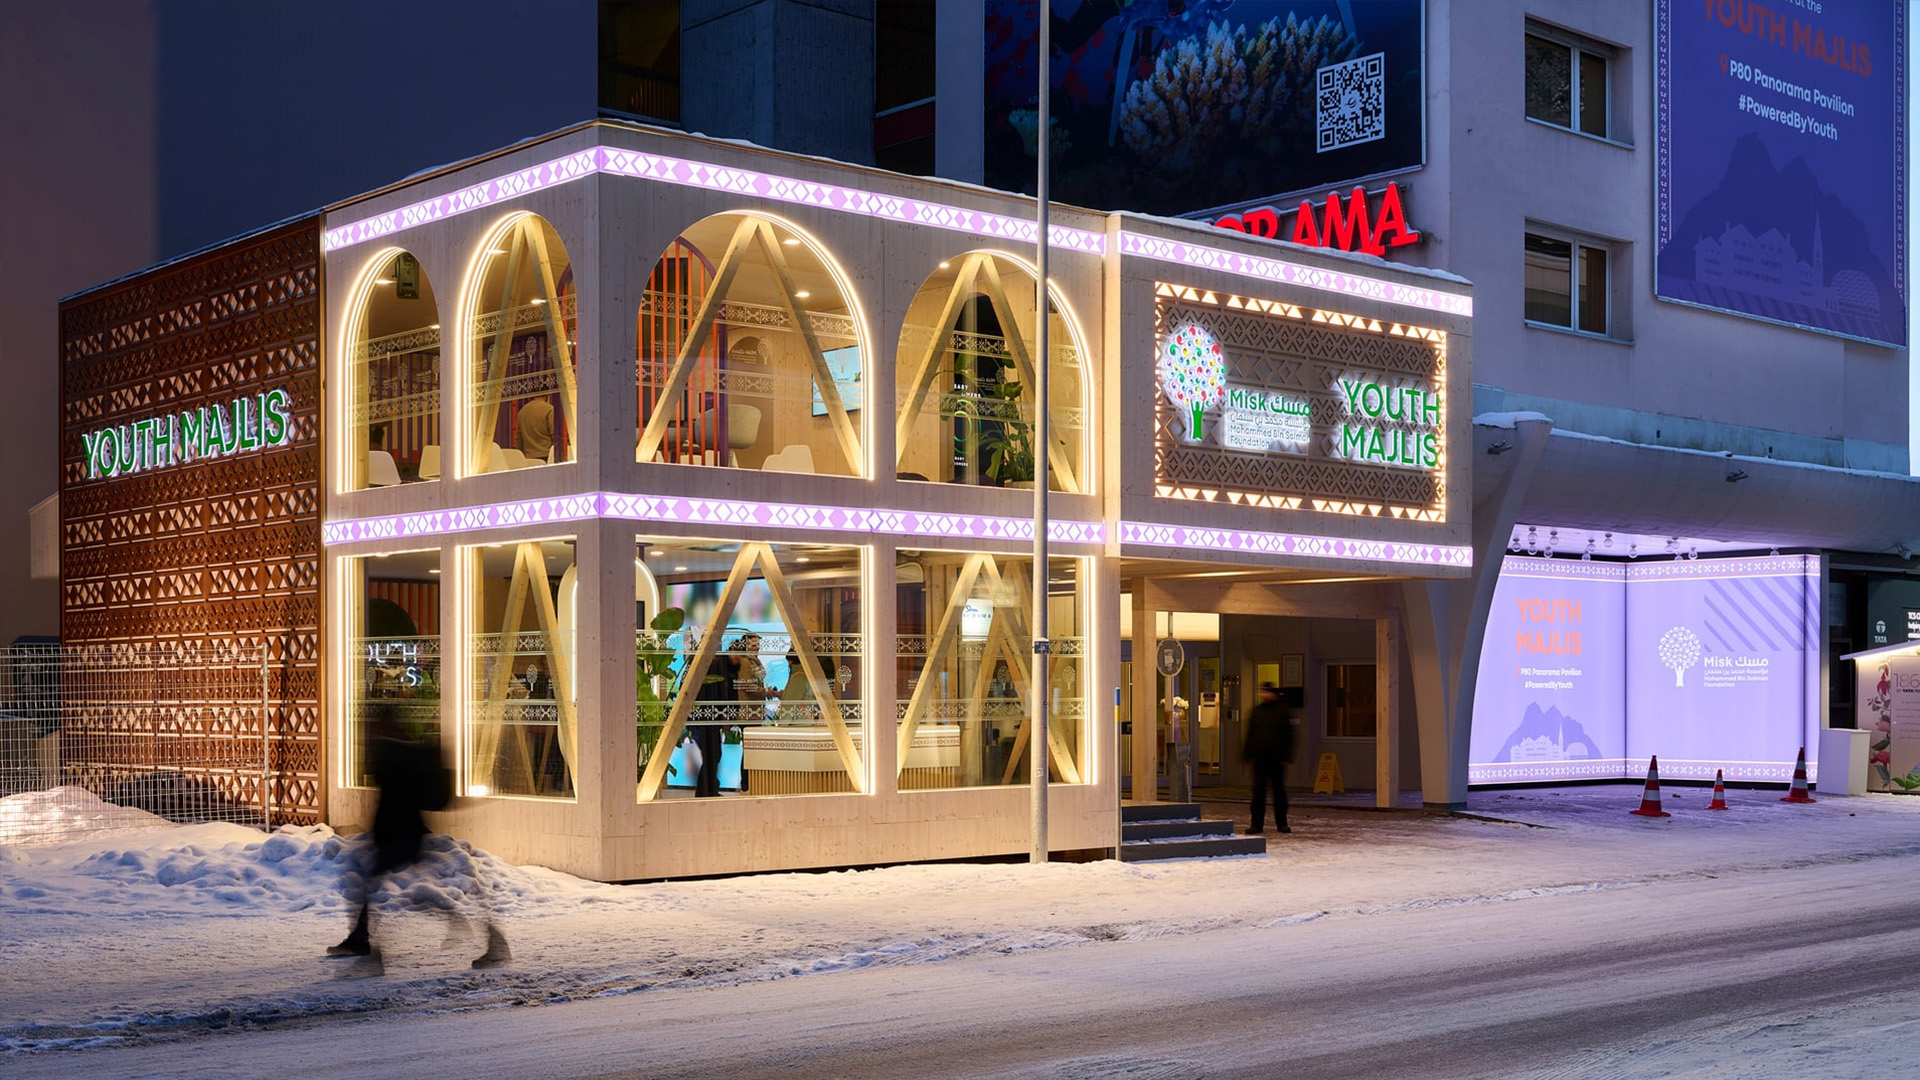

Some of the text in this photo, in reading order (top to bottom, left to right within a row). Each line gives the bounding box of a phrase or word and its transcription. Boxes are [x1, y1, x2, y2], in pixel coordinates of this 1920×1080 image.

[1704, 0, 1872, 78] YOUTH MAJLIS
[1730, 60, 1855, 117] P80 Panorama Pavilion
[1738, 94, 1838, 141] #PoweredByYouth
[1230, 389, 1267, 411] Misk
[1270, 396, 1311, 417] مسك
[1342, 380, 1440, 425] YOUTH
[81, 389, 288, 479] YOUTH MAJLIS
[1230, 424, 1311, 443] Mohammed Bin Salman
[1230, 435, 1270, 449] Foundation
[1342, 425, 1439, 467] MAJLIS
[1516, 597, 1581, 623] YOUTH
[1516, 629, 1581, 655] MAJLIS
[1874, 635, 1887, 643] TATA
[1704, 656, 1732, 667] Misk
[1735, 656, 1768, 667] مسك
